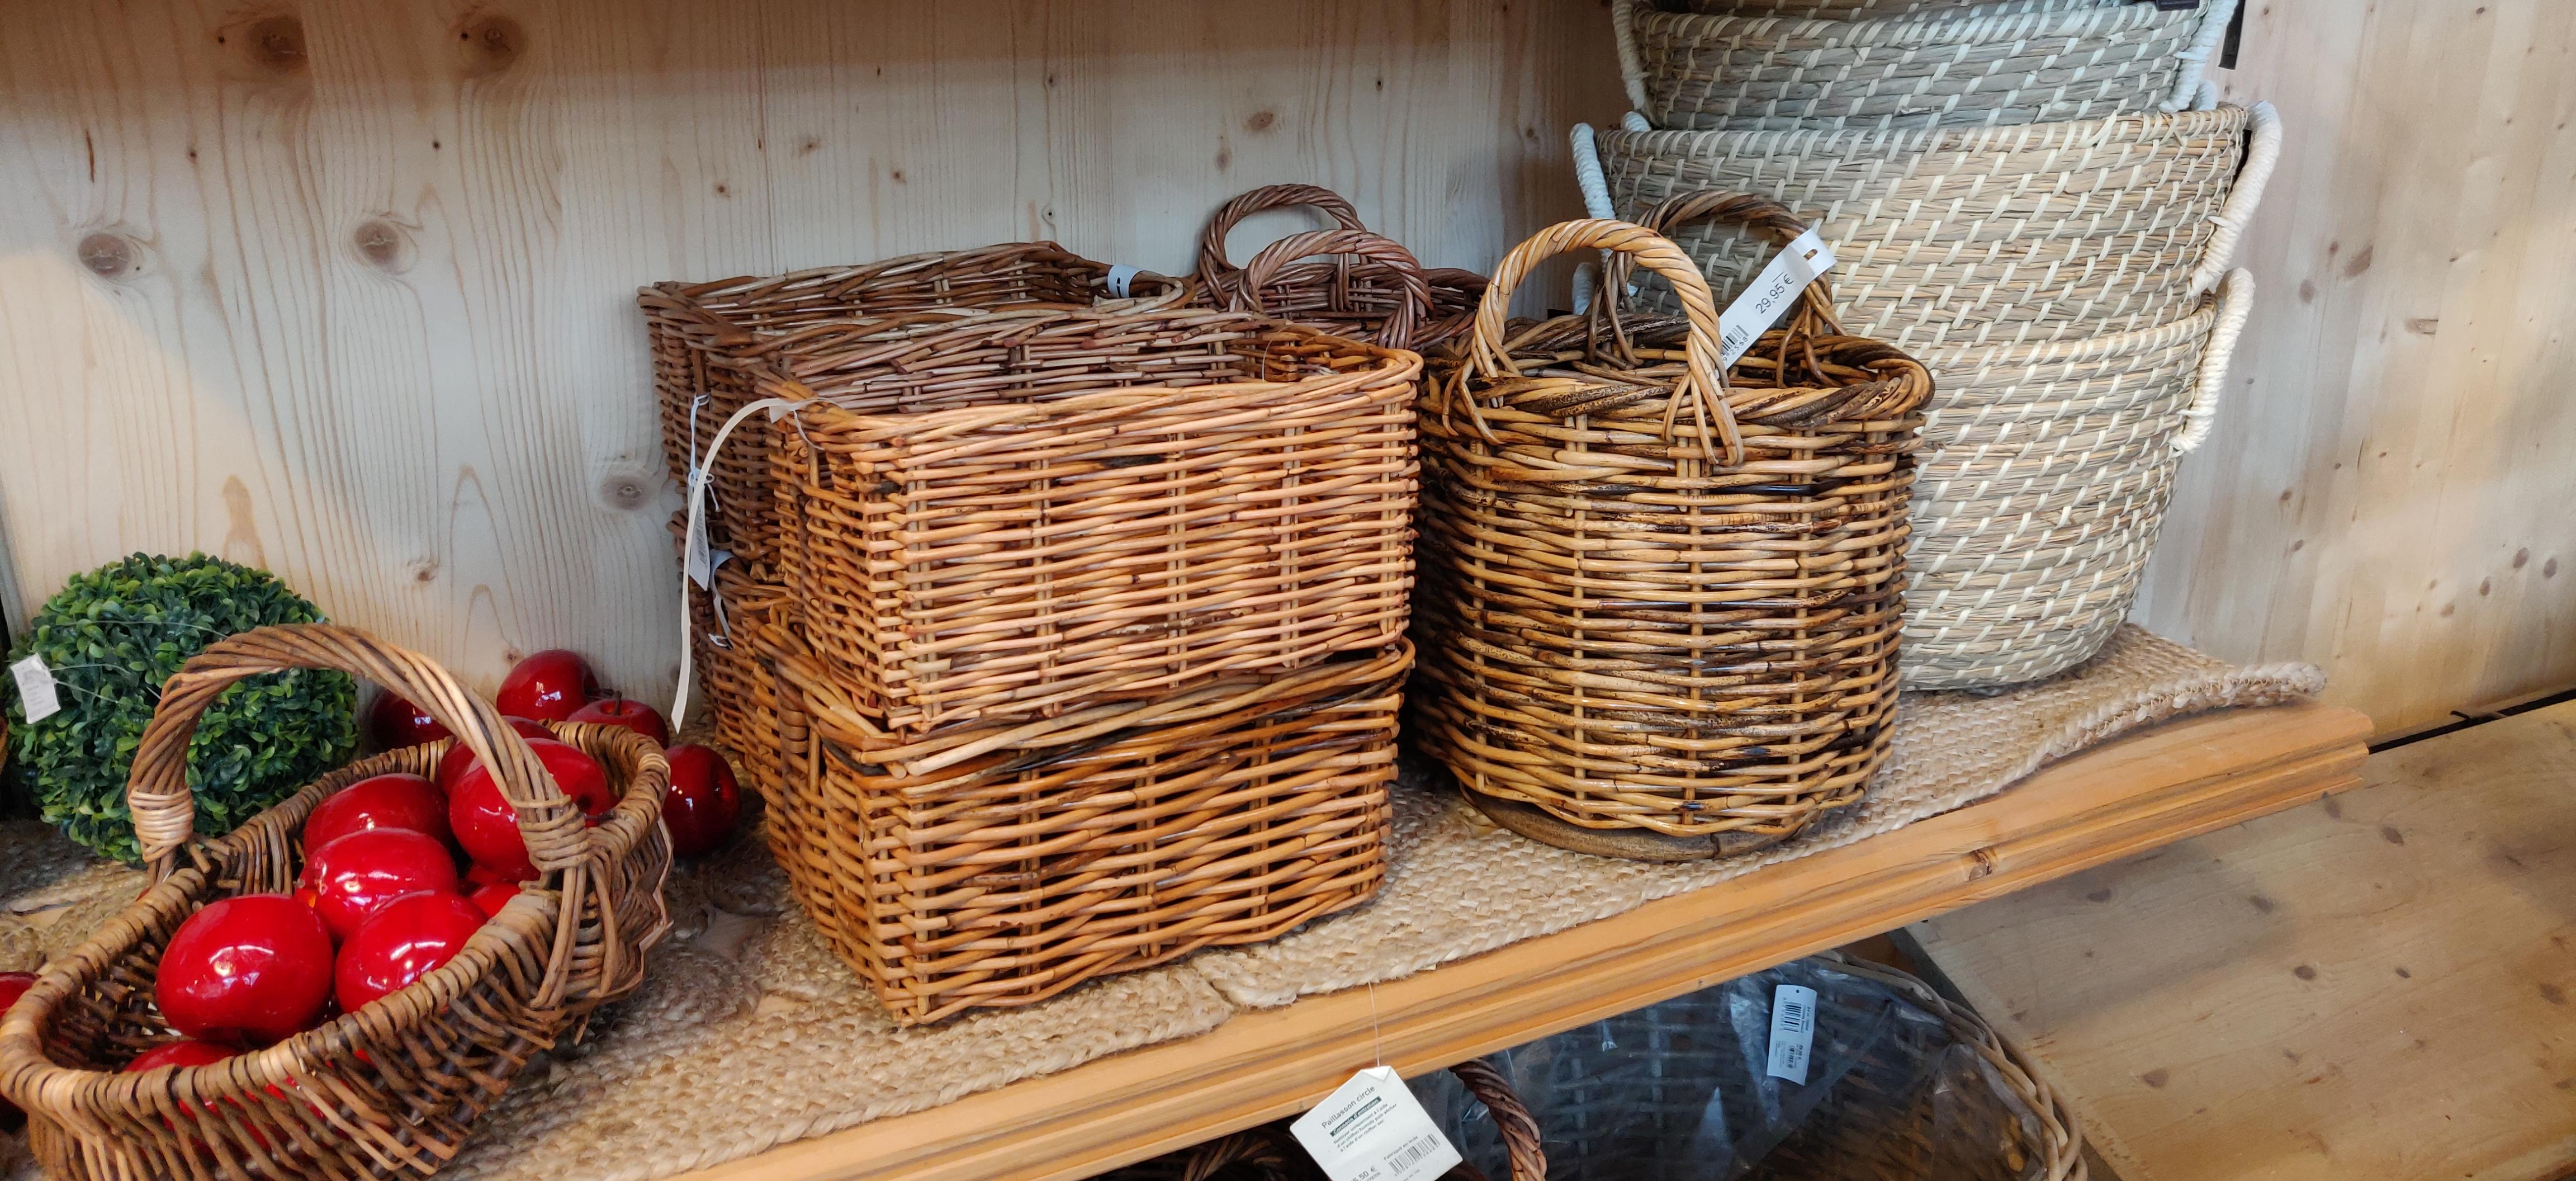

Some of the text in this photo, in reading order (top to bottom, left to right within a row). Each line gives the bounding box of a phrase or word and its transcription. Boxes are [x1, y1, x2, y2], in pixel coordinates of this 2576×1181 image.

[1783, 273, 1794, 285] €
[1321, 1085, 1375, 1129] Paillasson circle
